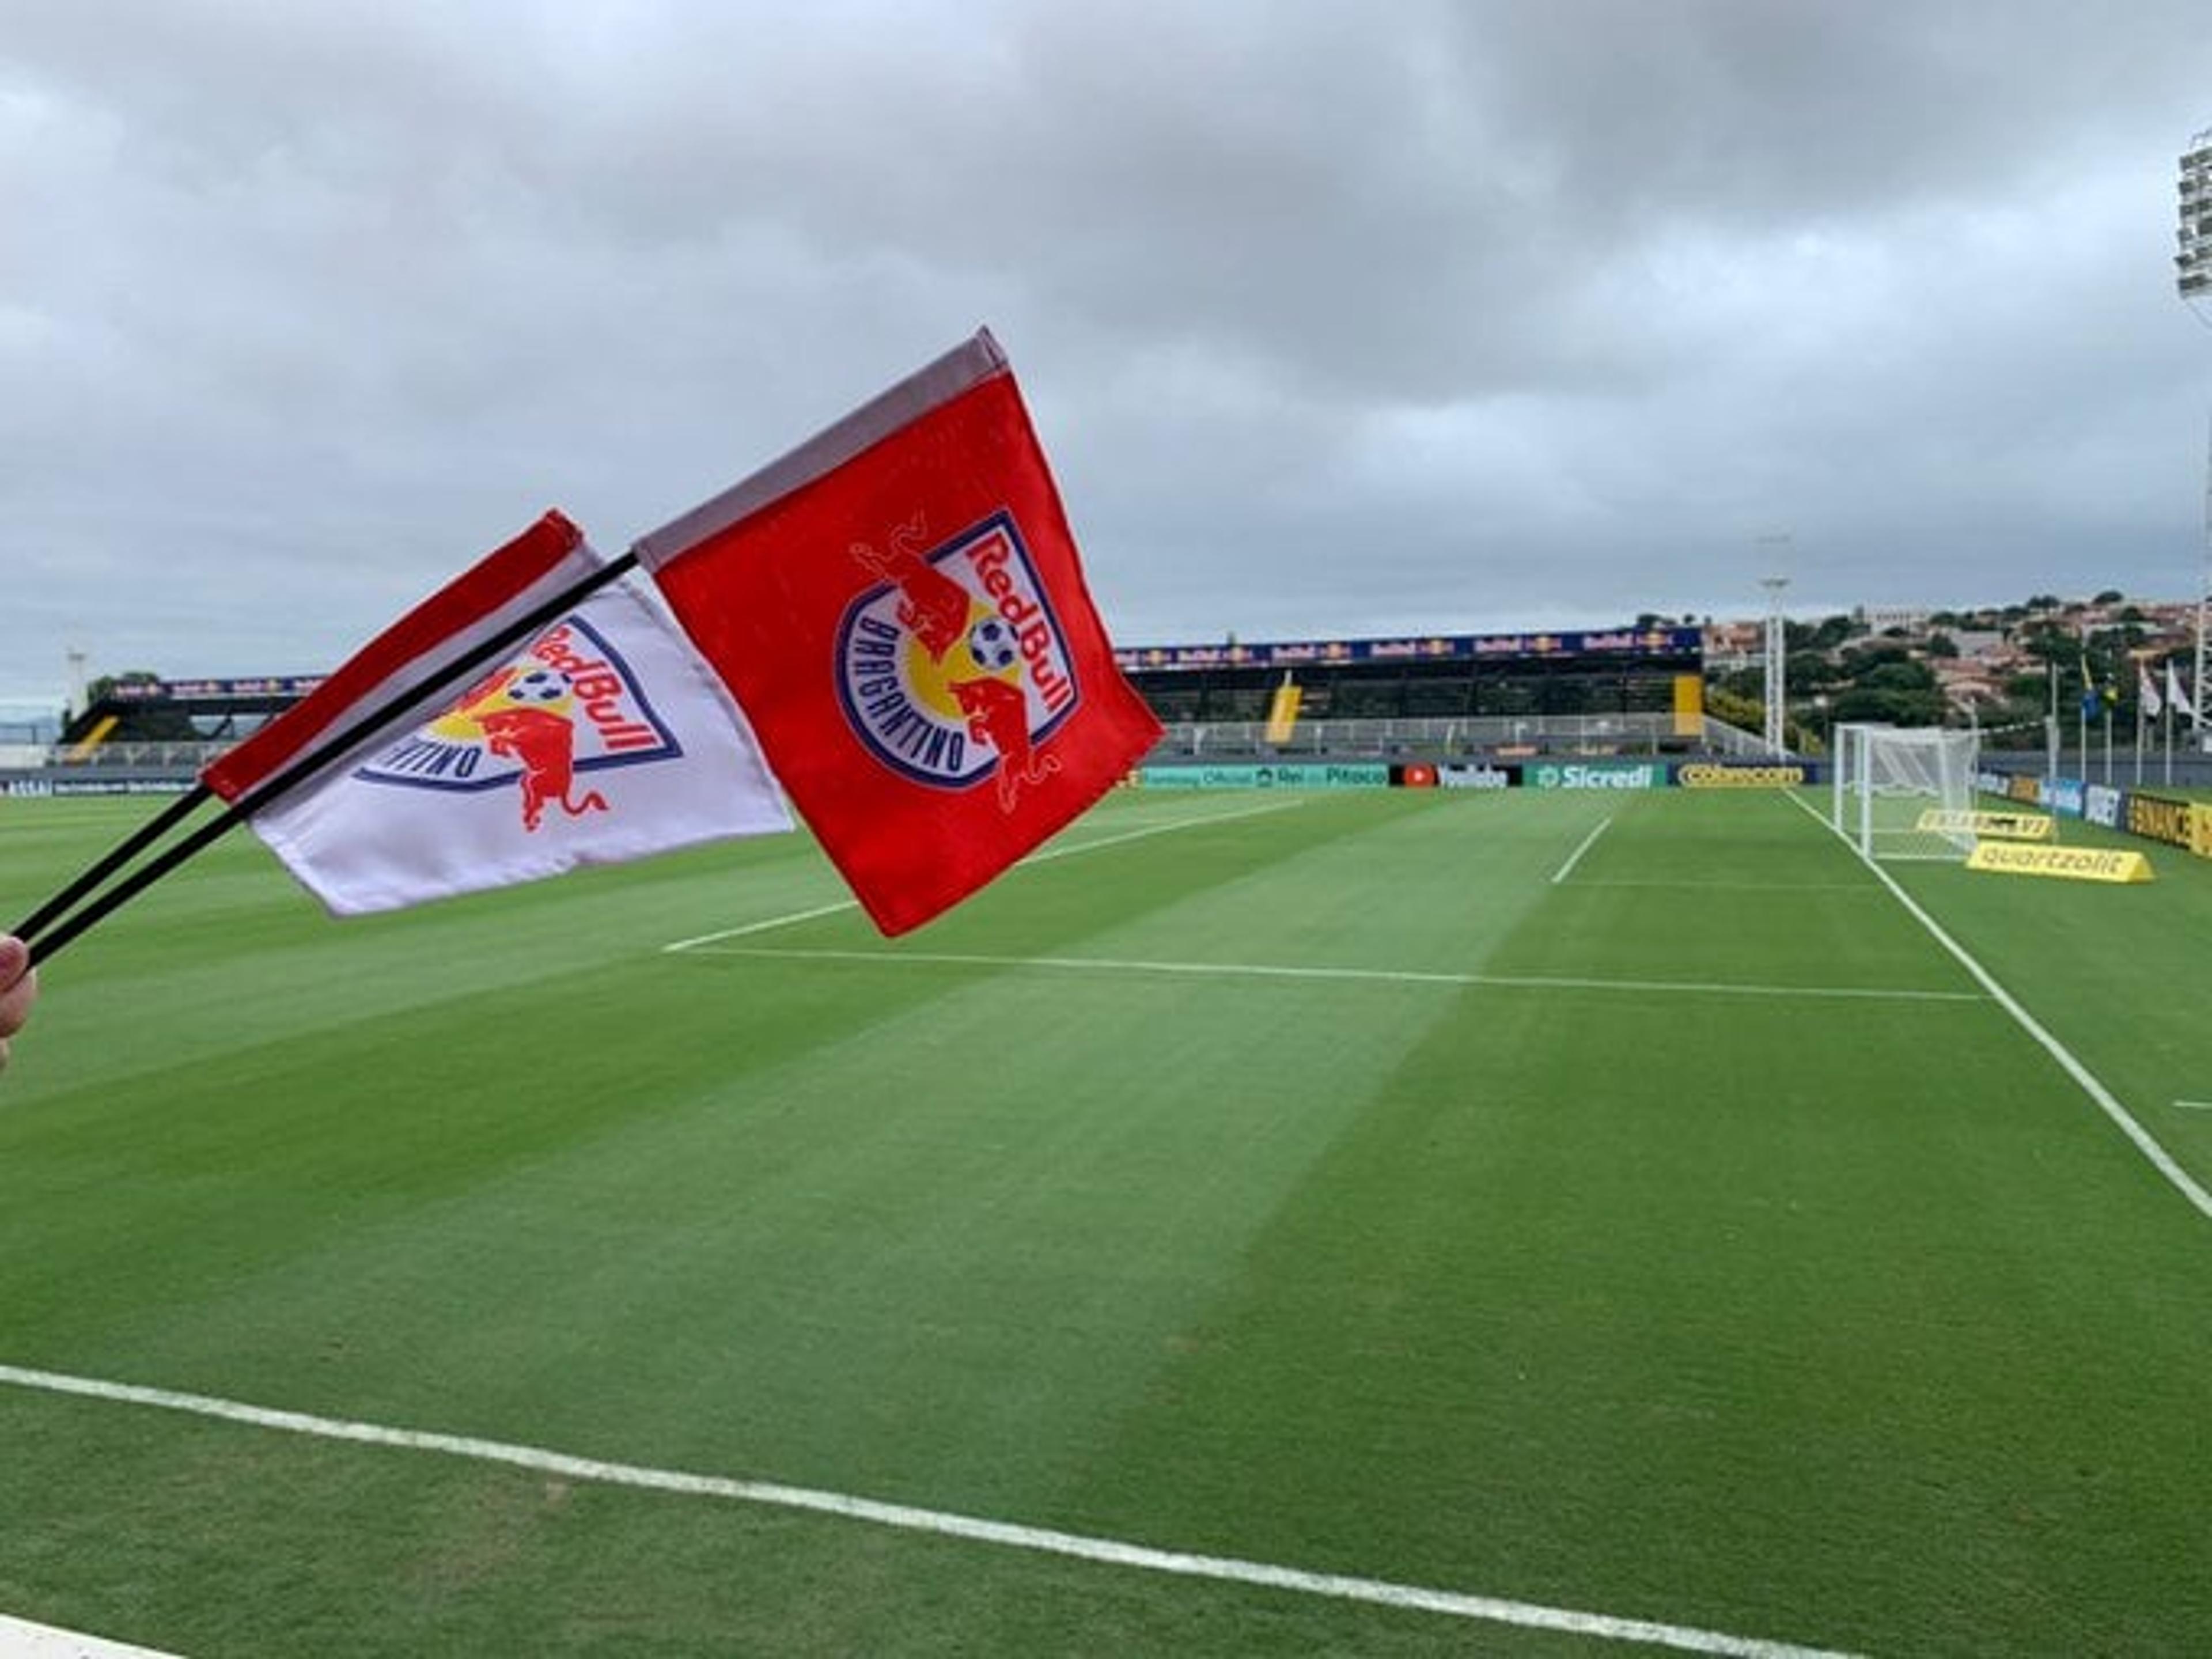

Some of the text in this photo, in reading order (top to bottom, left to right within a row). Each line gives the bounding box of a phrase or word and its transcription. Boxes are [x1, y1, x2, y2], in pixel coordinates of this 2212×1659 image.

[854, 616, 964, 772] BRAGANTINO
[1562, 764, 1653, 789] Sicredi
[1982, 847, 2123, 874] quartzolit
